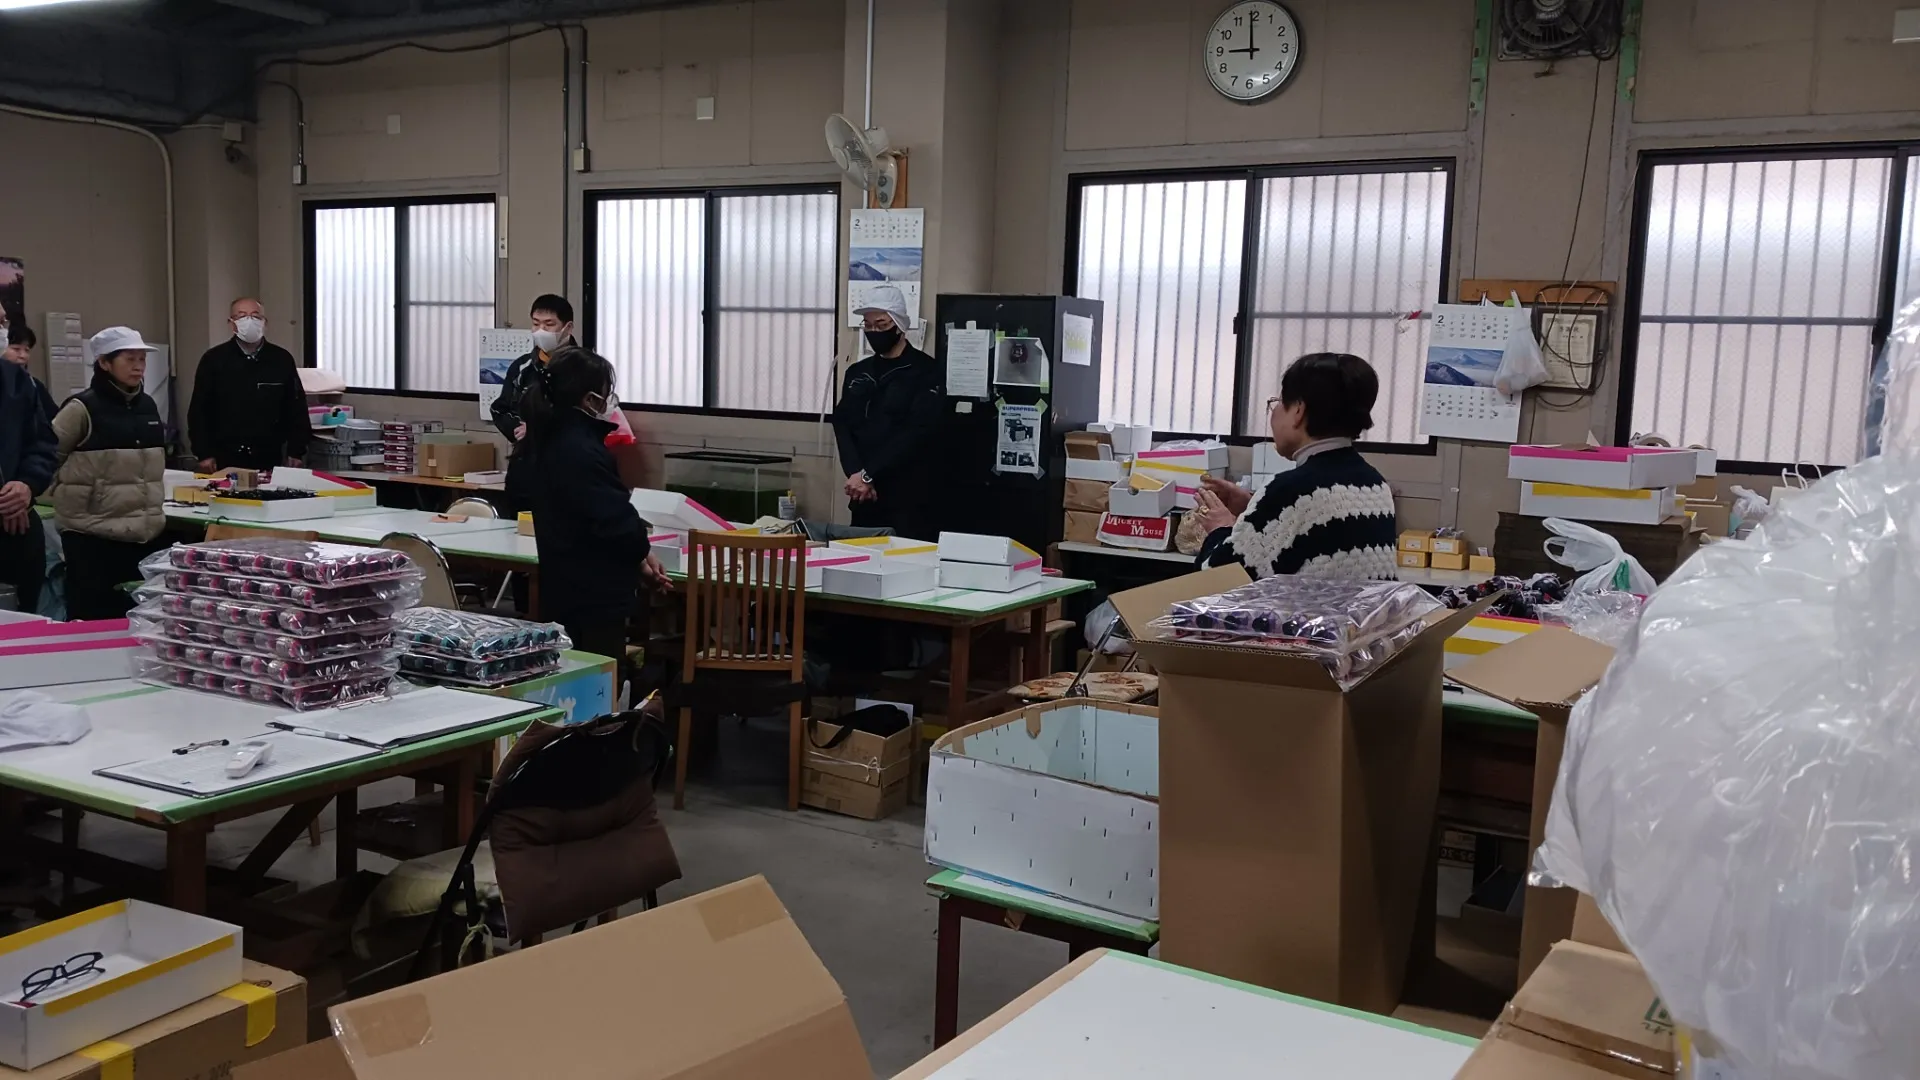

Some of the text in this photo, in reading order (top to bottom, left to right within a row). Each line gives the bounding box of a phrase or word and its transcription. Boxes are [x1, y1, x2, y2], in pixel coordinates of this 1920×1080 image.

[1234, 17, 1242, 26] 11
[1268, 14, 1273, 24] 1
[1220, 30, 1232, 40] 10
[1277, 26, 1285, 37] 2
[1216, 47, 1224, 57] 9
[1281, 43, 1289, 53] 3
[1219, 63, 1227, 73] 8
[1275, 61, 1283, 71] 4
[1231, 76, 1238, 86] 7
[1245, 79, 1253, 89] 6
[1262, 74, 1270, 84] 5
[1438, 315, 1444, 323] 2
[1106, 514, 1142, 526] MICKEY
[1130, 525, 1163, 536] MOUSE
